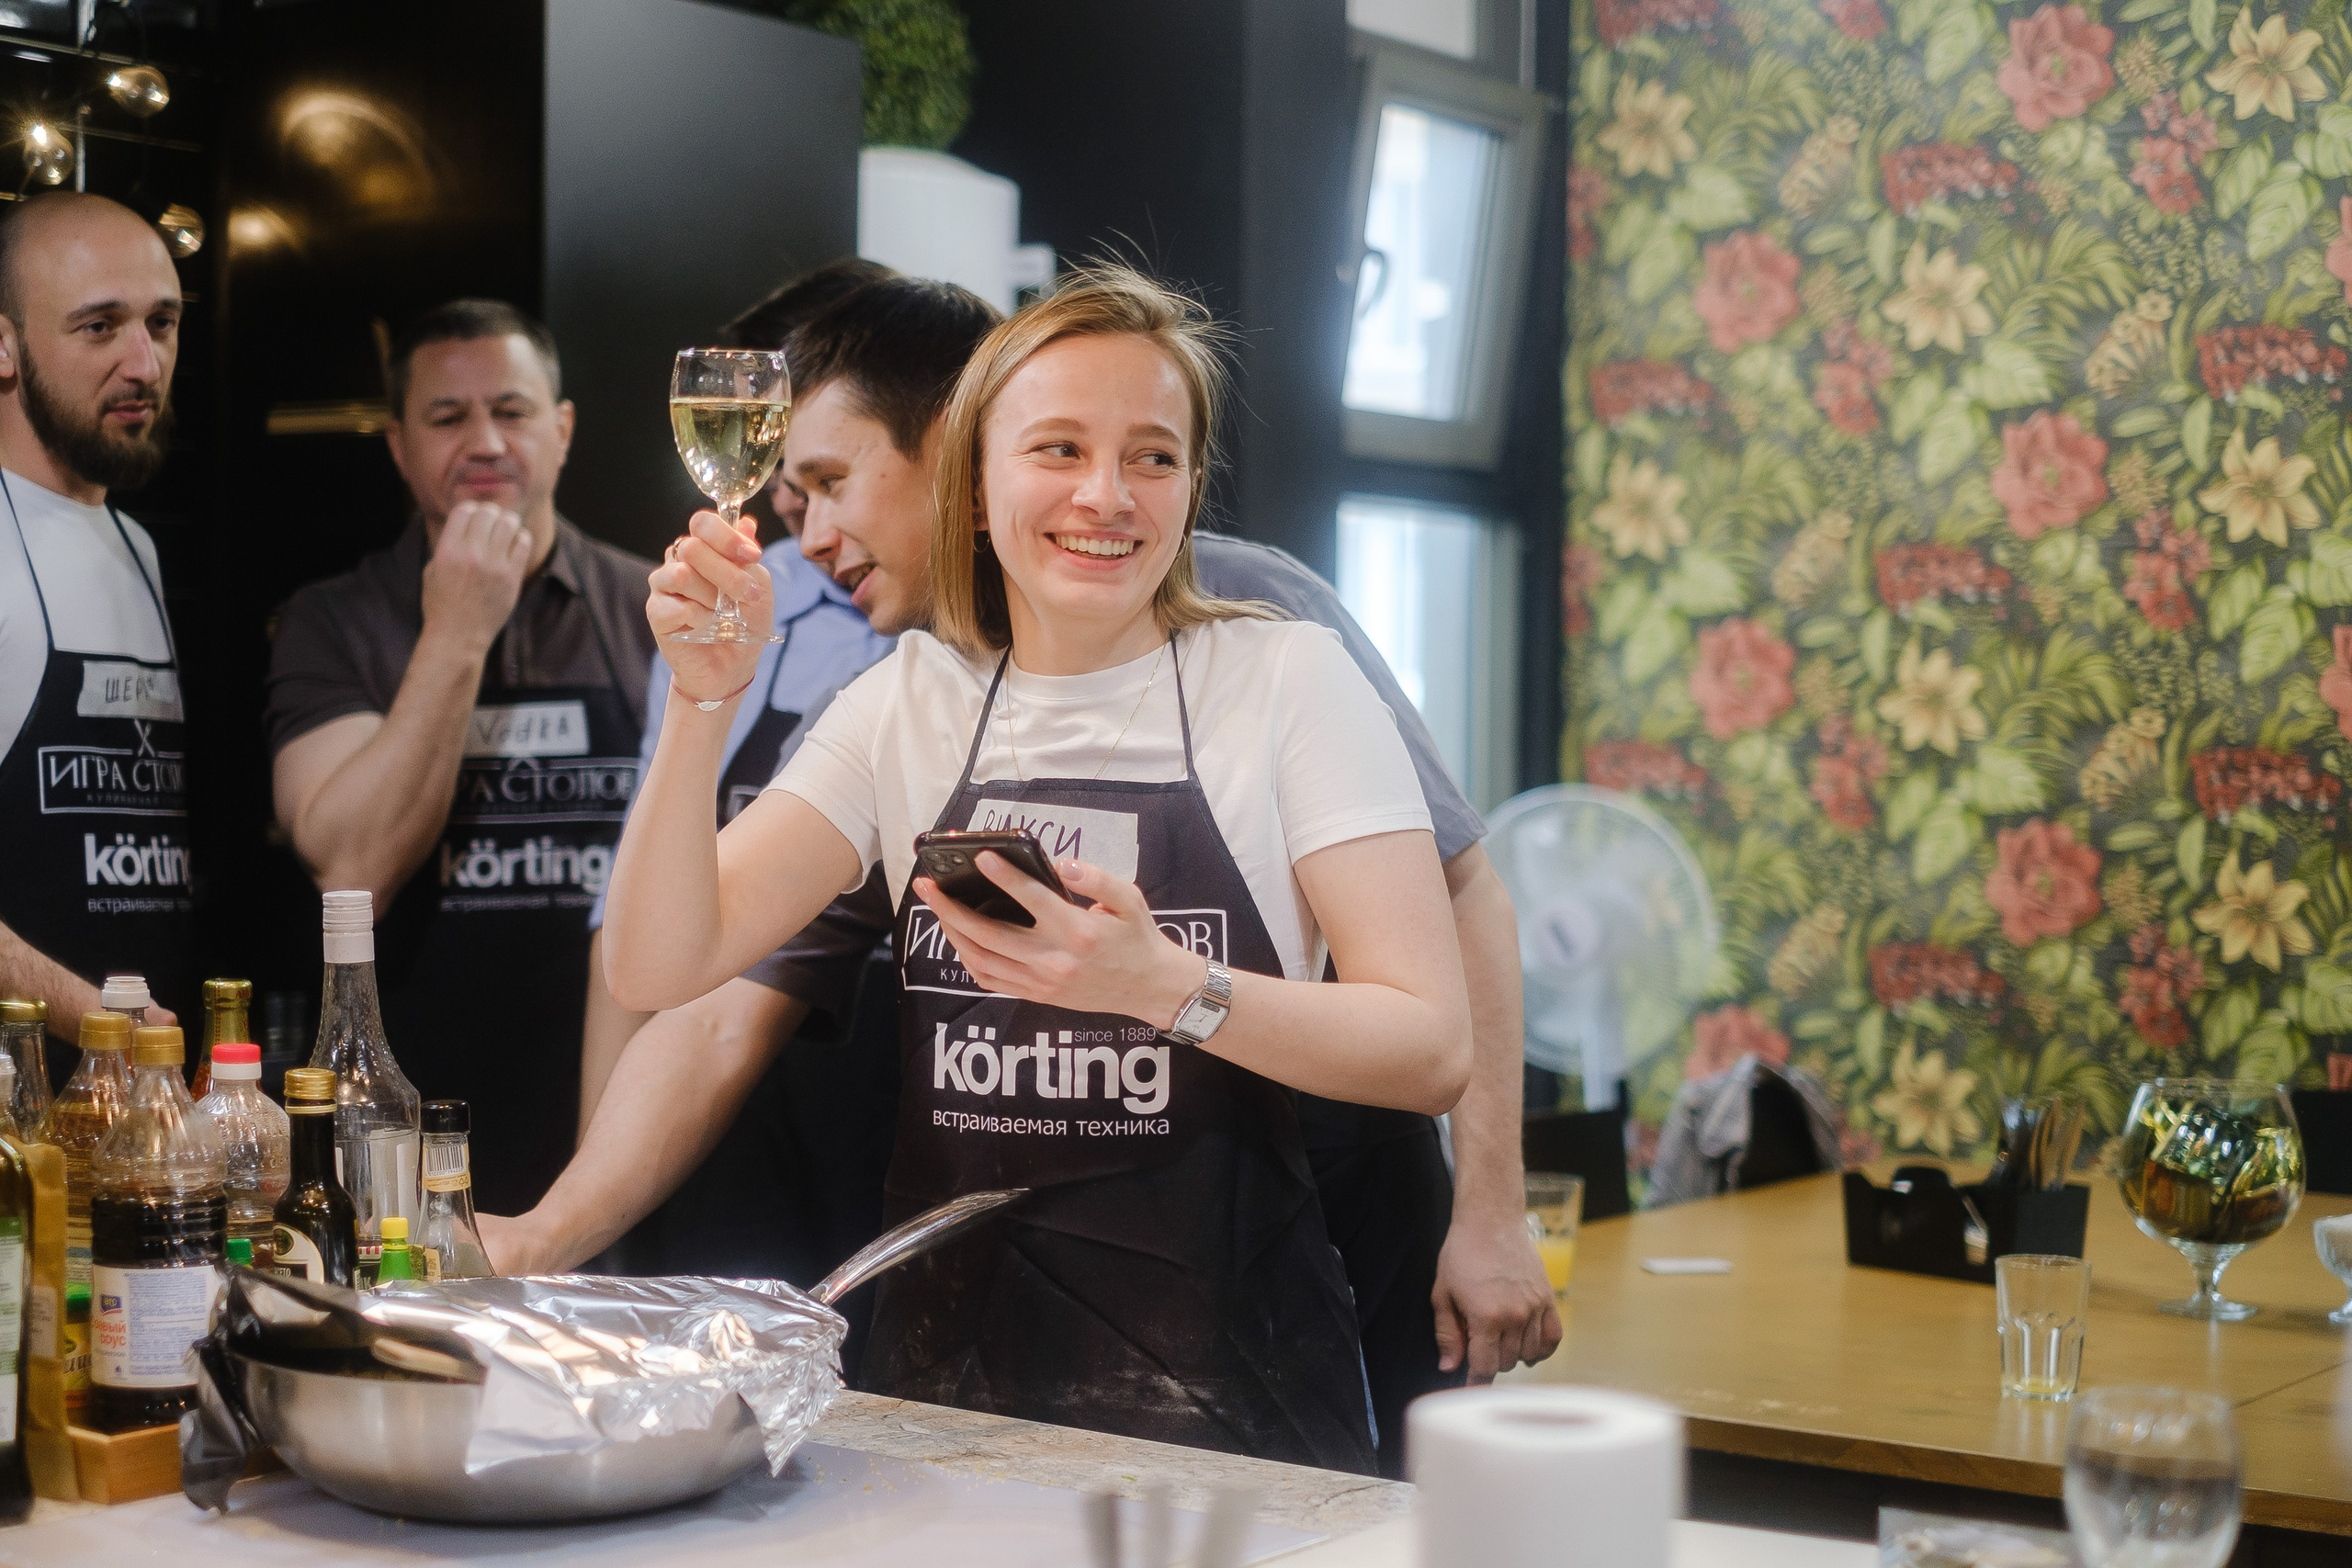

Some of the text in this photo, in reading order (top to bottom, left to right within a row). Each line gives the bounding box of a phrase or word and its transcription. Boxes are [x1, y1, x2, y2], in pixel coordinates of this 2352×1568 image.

[50, 754, 127, 790] ИГРА
[85, 833, 192, 887] körtin
[1074, 1027, 1156, 1042] since 1889
[933, 1022, 1170, 1114] körting
[933, 1110, 1170, 1136] встраиваемая техника
